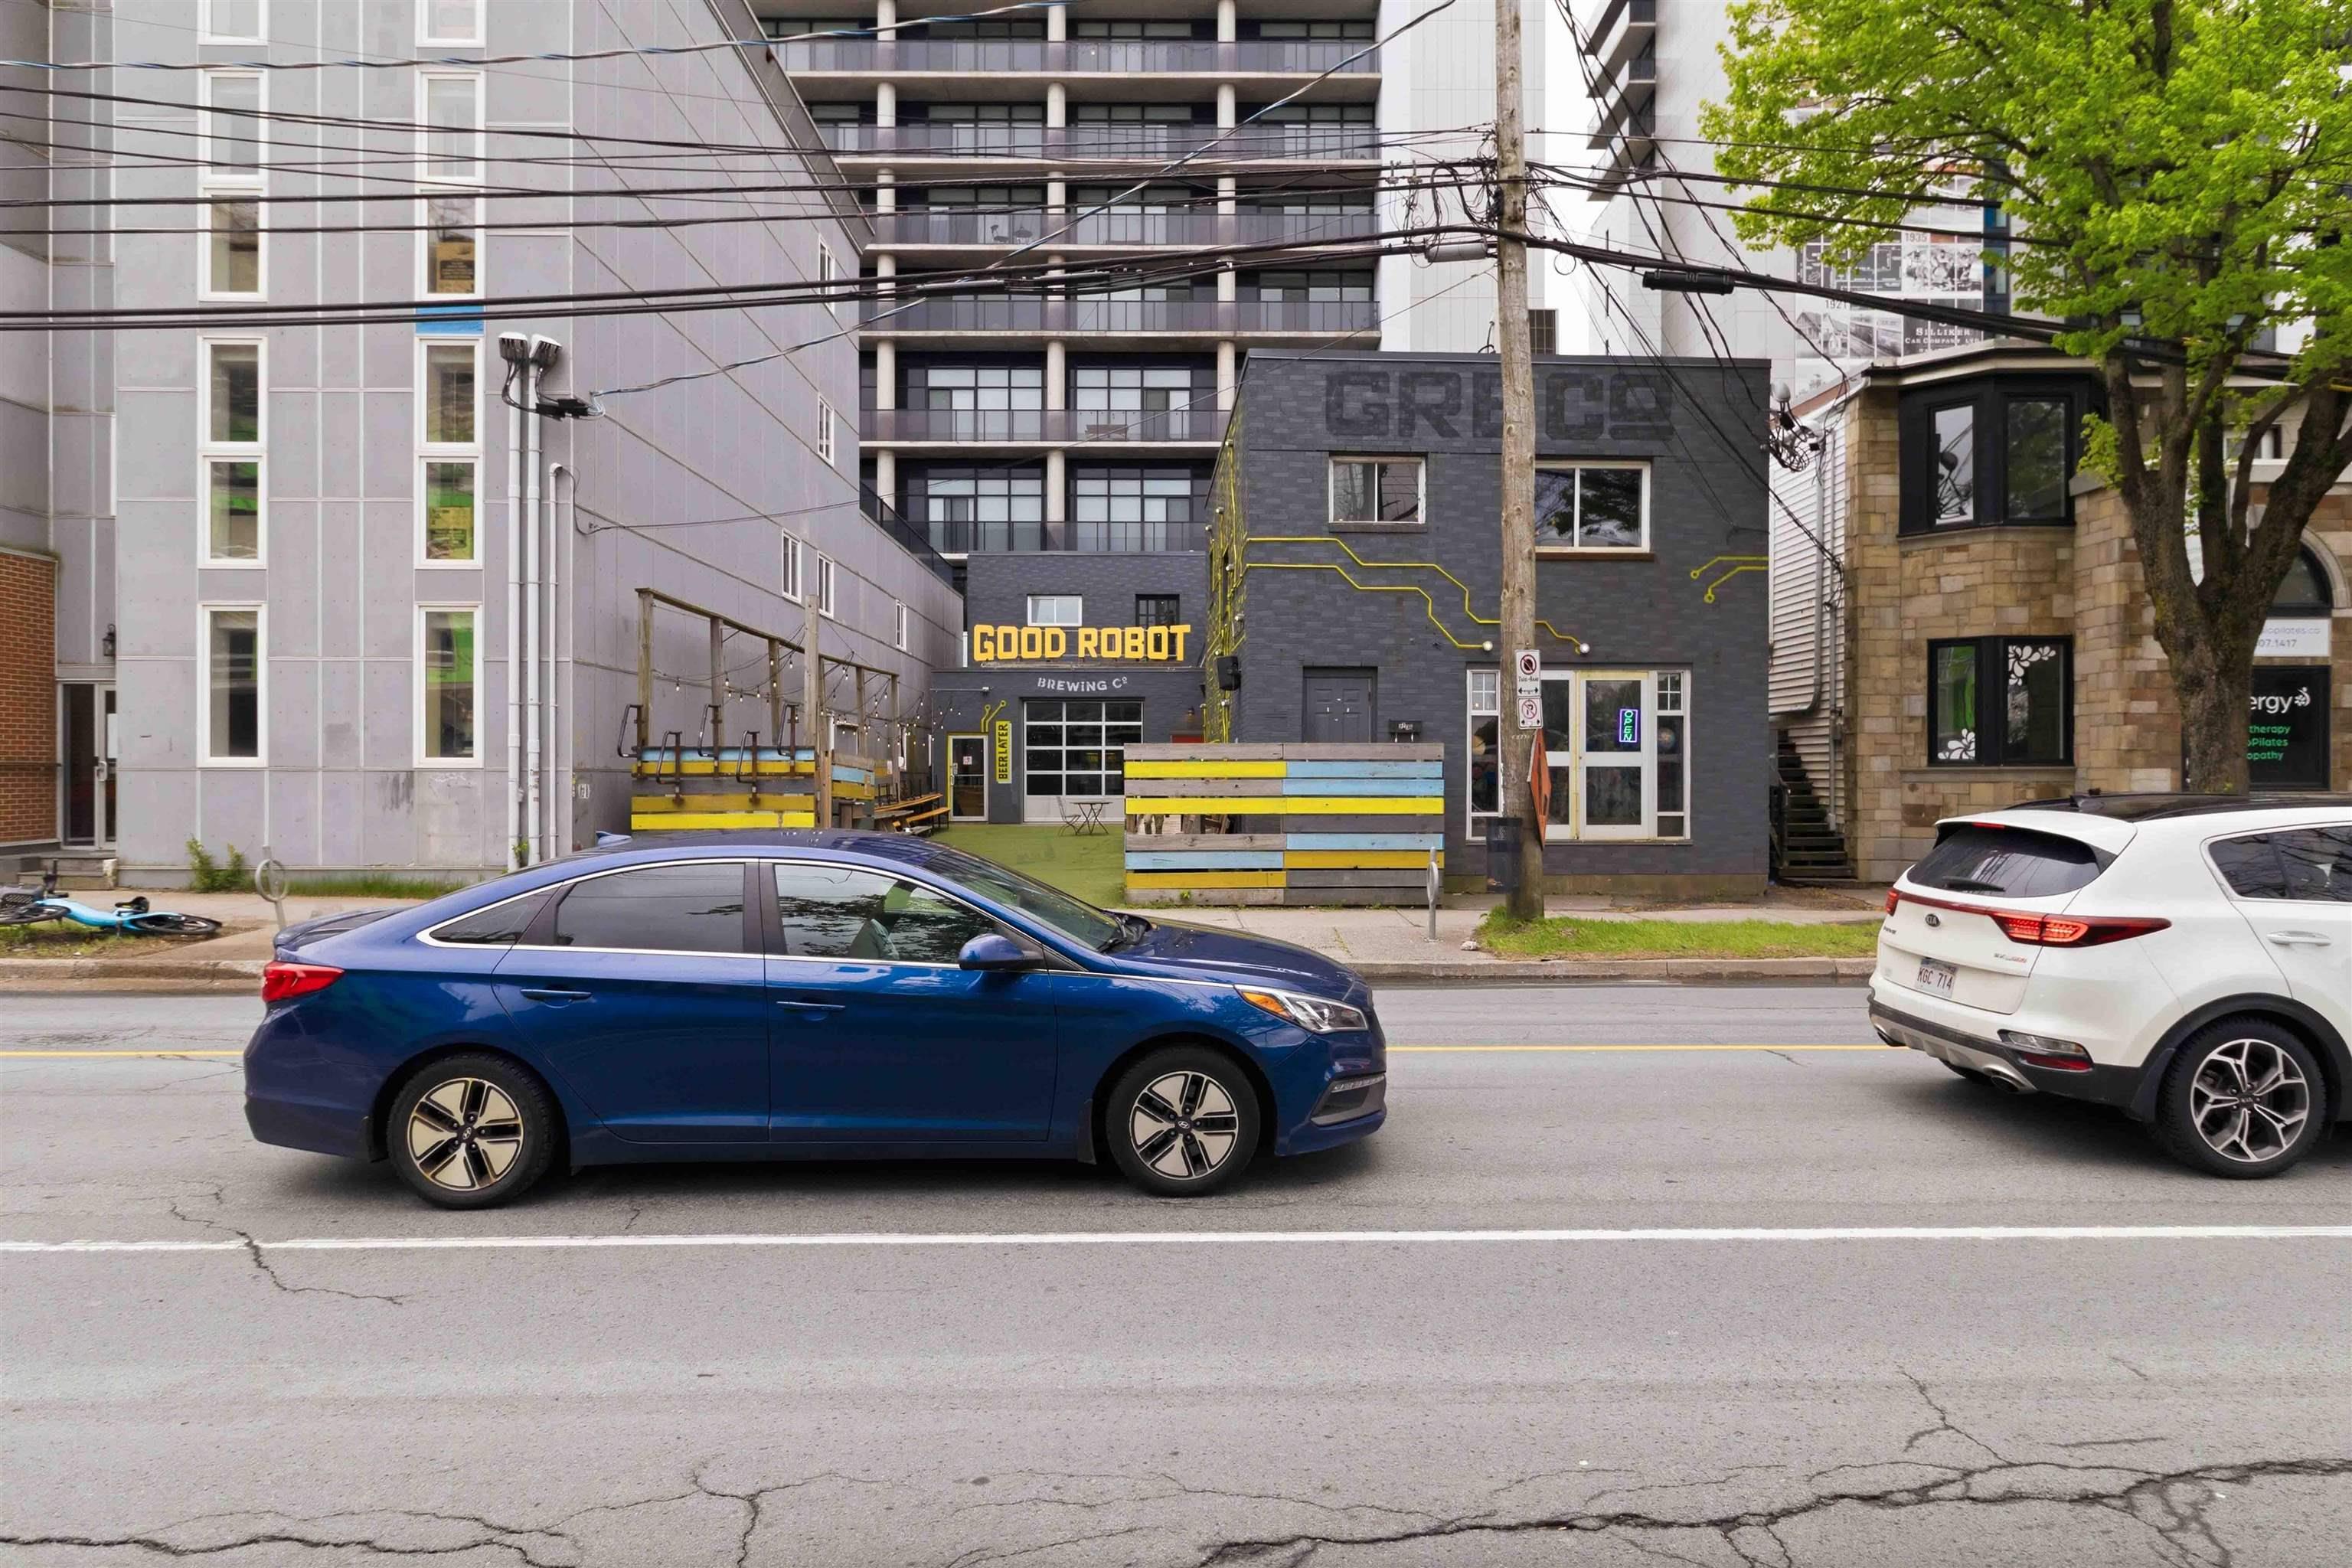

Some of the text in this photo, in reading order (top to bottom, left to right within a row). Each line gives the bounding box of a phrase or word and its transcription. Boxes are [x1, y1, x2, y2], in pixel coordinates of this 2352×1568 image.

[974, 624, 1191, 661] GOOD ROBOT
[1624, 710, 1633, 741] OPEN
[2249, 726, 2291, 734] therapy
[998, 724, 1008, 779] BEER LATER
[1917, 967, 1953, 991] KGC 714
